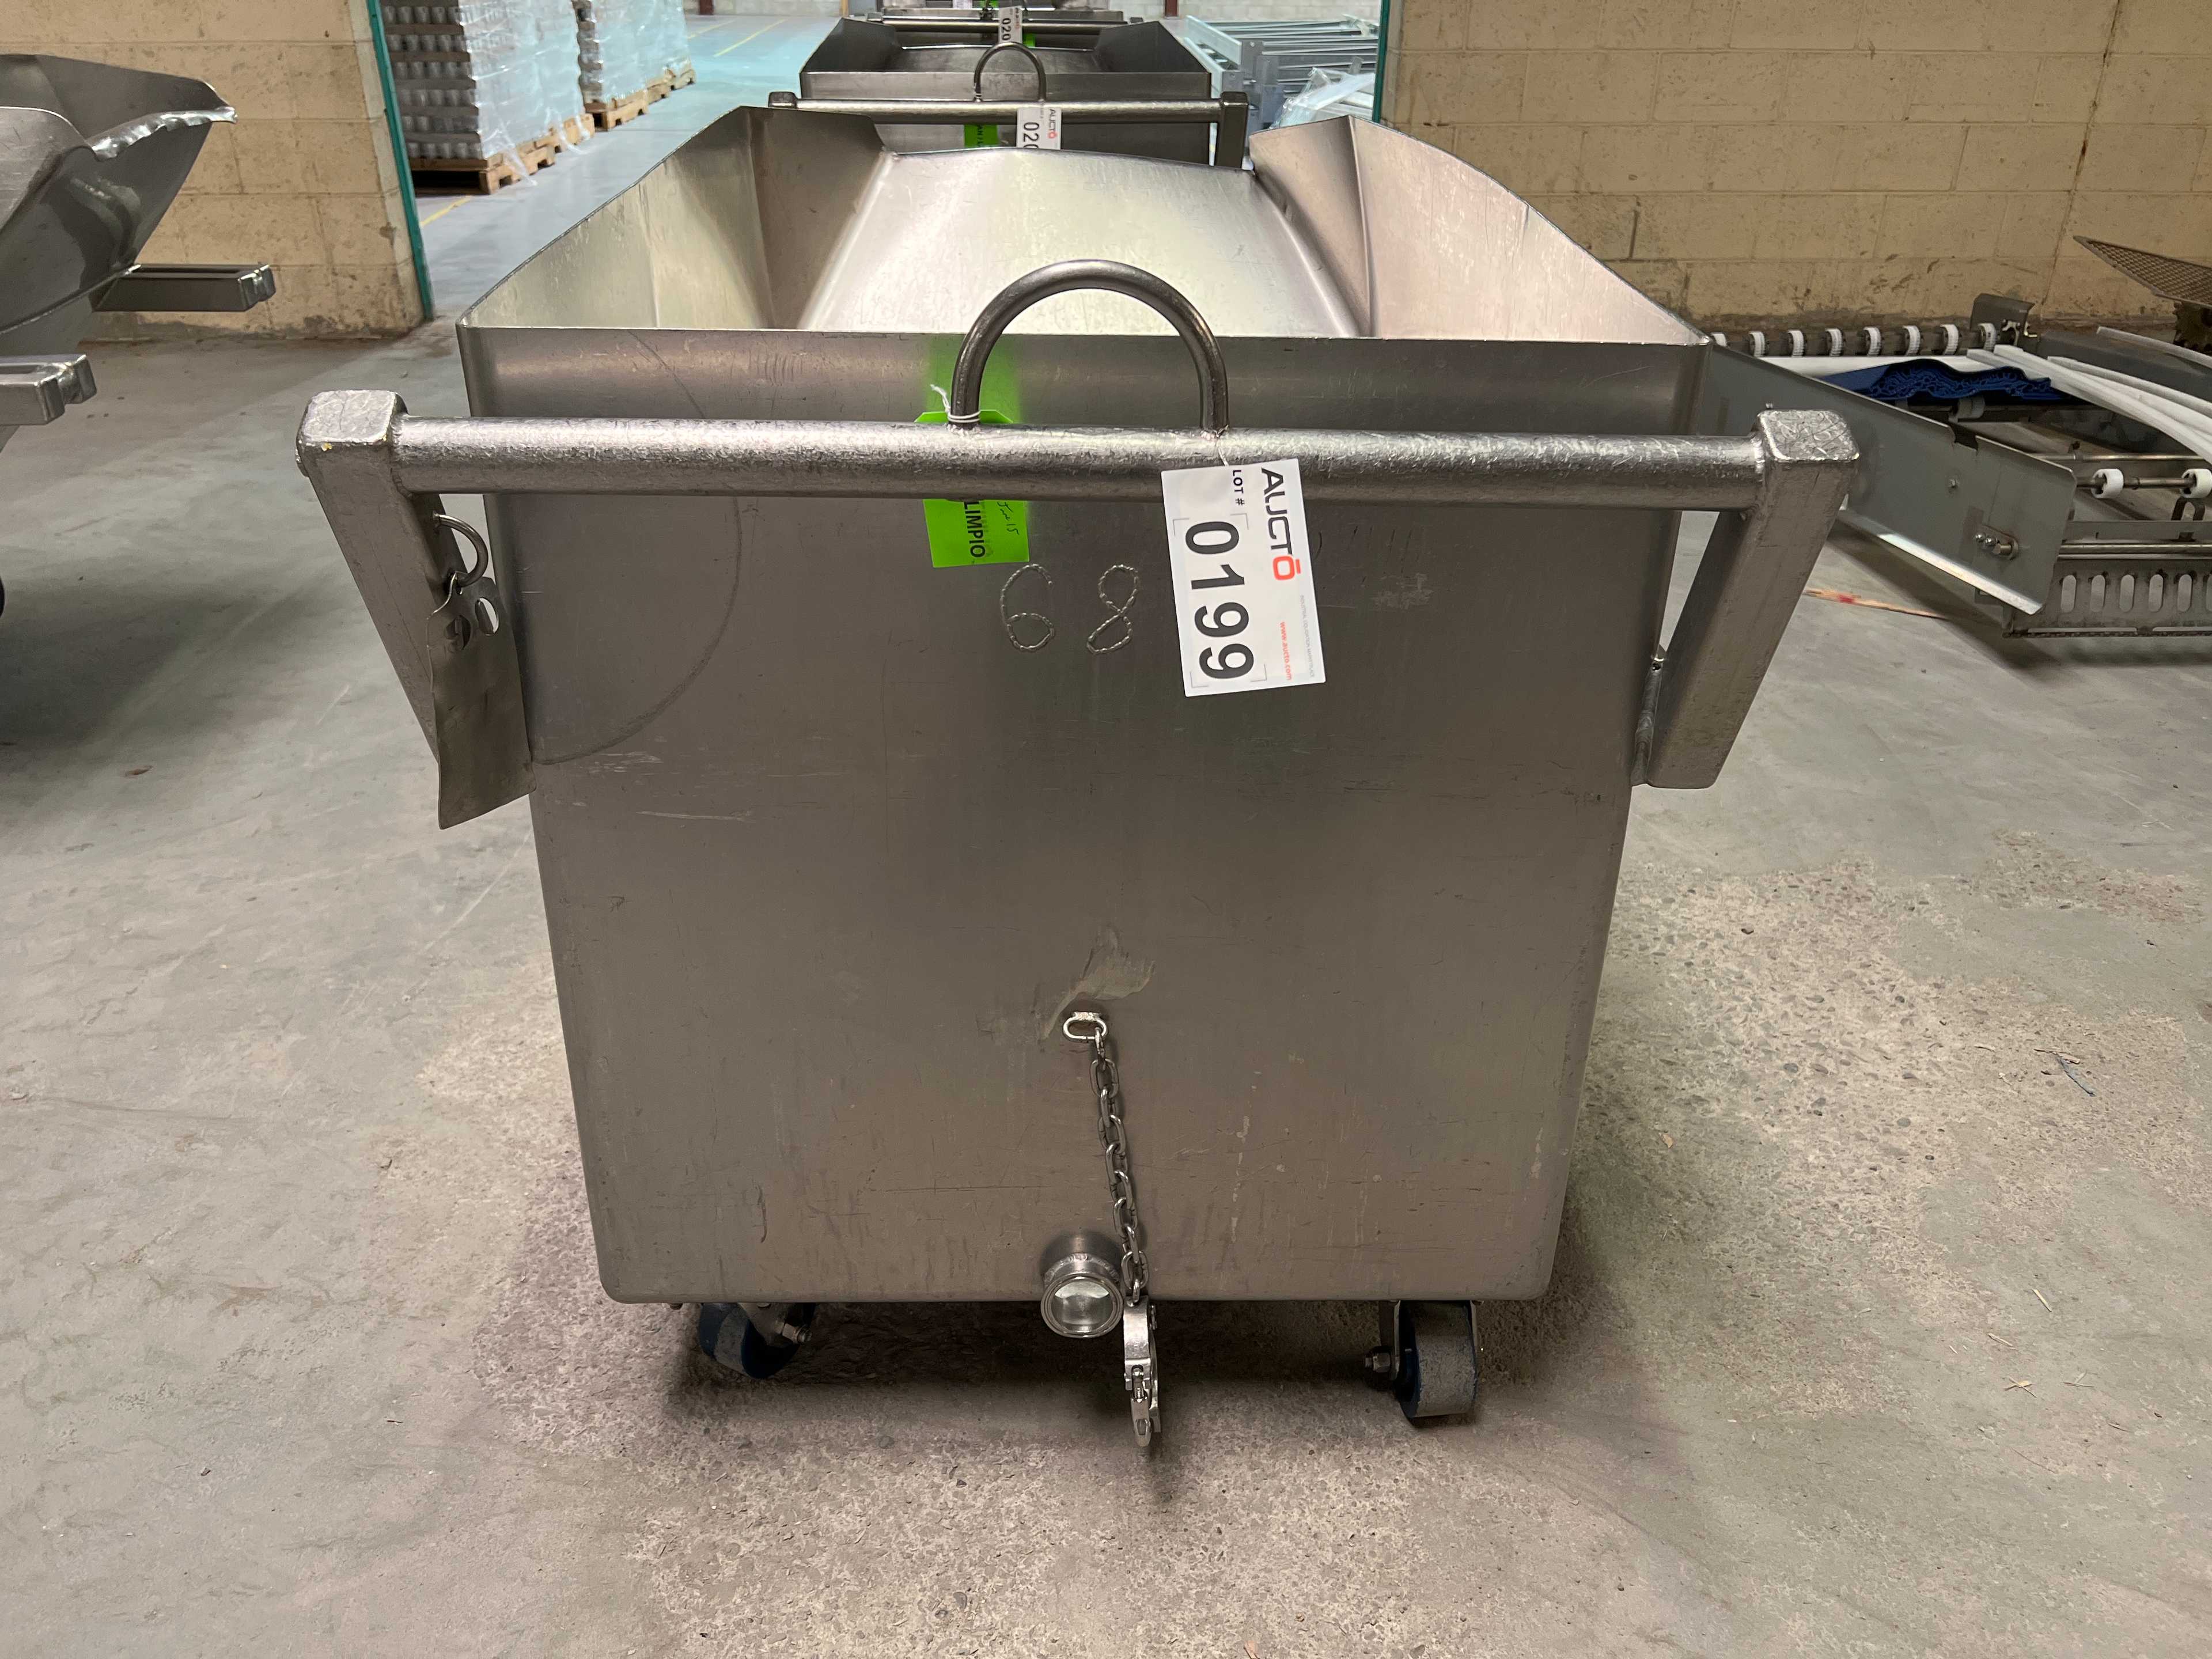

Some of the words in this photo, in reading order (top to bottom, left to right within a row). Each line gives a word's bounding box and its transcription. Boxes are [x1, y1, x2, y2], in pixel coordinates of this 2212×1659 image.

[1232, 469, 1244, 494] LOT
[1235, 498, 1245, 506] #
[964, 501, 986, 558] LIMPIO
[1185, 521, 1254, 679] 01199
[1279, 622, 1293, 680] www.aucto.com
